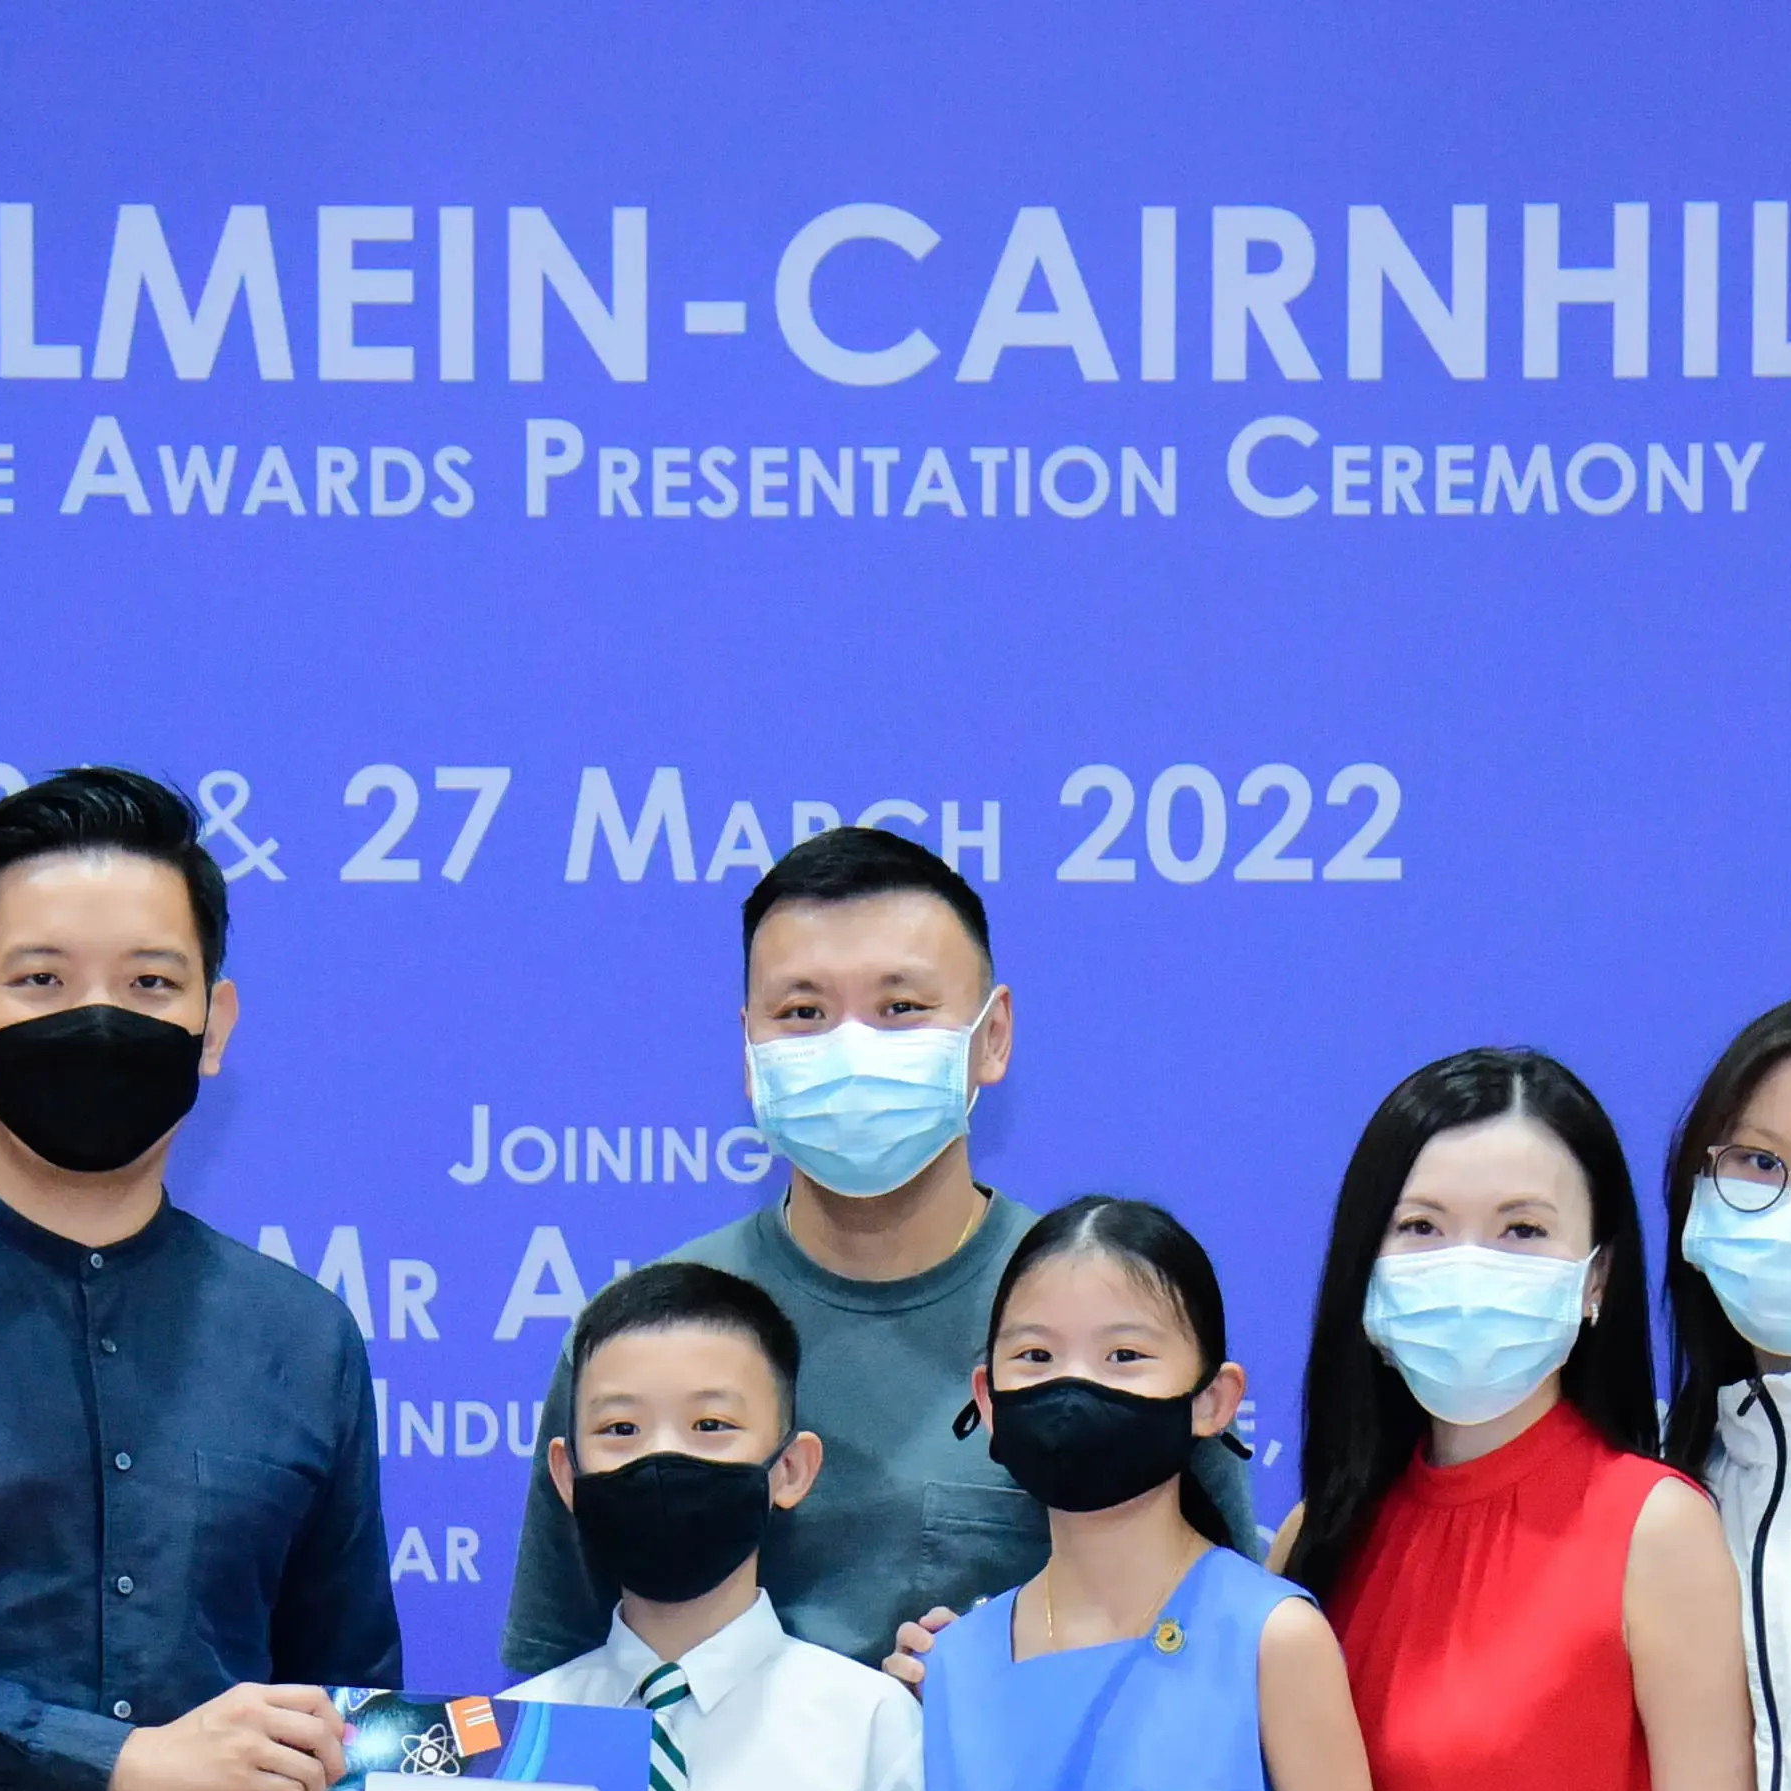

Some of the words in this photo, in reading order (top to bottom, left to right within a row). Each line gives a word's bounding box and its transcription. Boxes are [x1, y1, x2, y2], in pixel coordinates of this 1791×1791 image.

[60, 417, 474, 518] AWARDS
[527, 418, 1177, 518] PRESENTATION
[1227, 416, 1765, 518] CEREMONY
[340, 764, 511, 883] 27
[1056, 763, 1402, 883] 2022
[448, 1104, 773, 1184] JOINING
